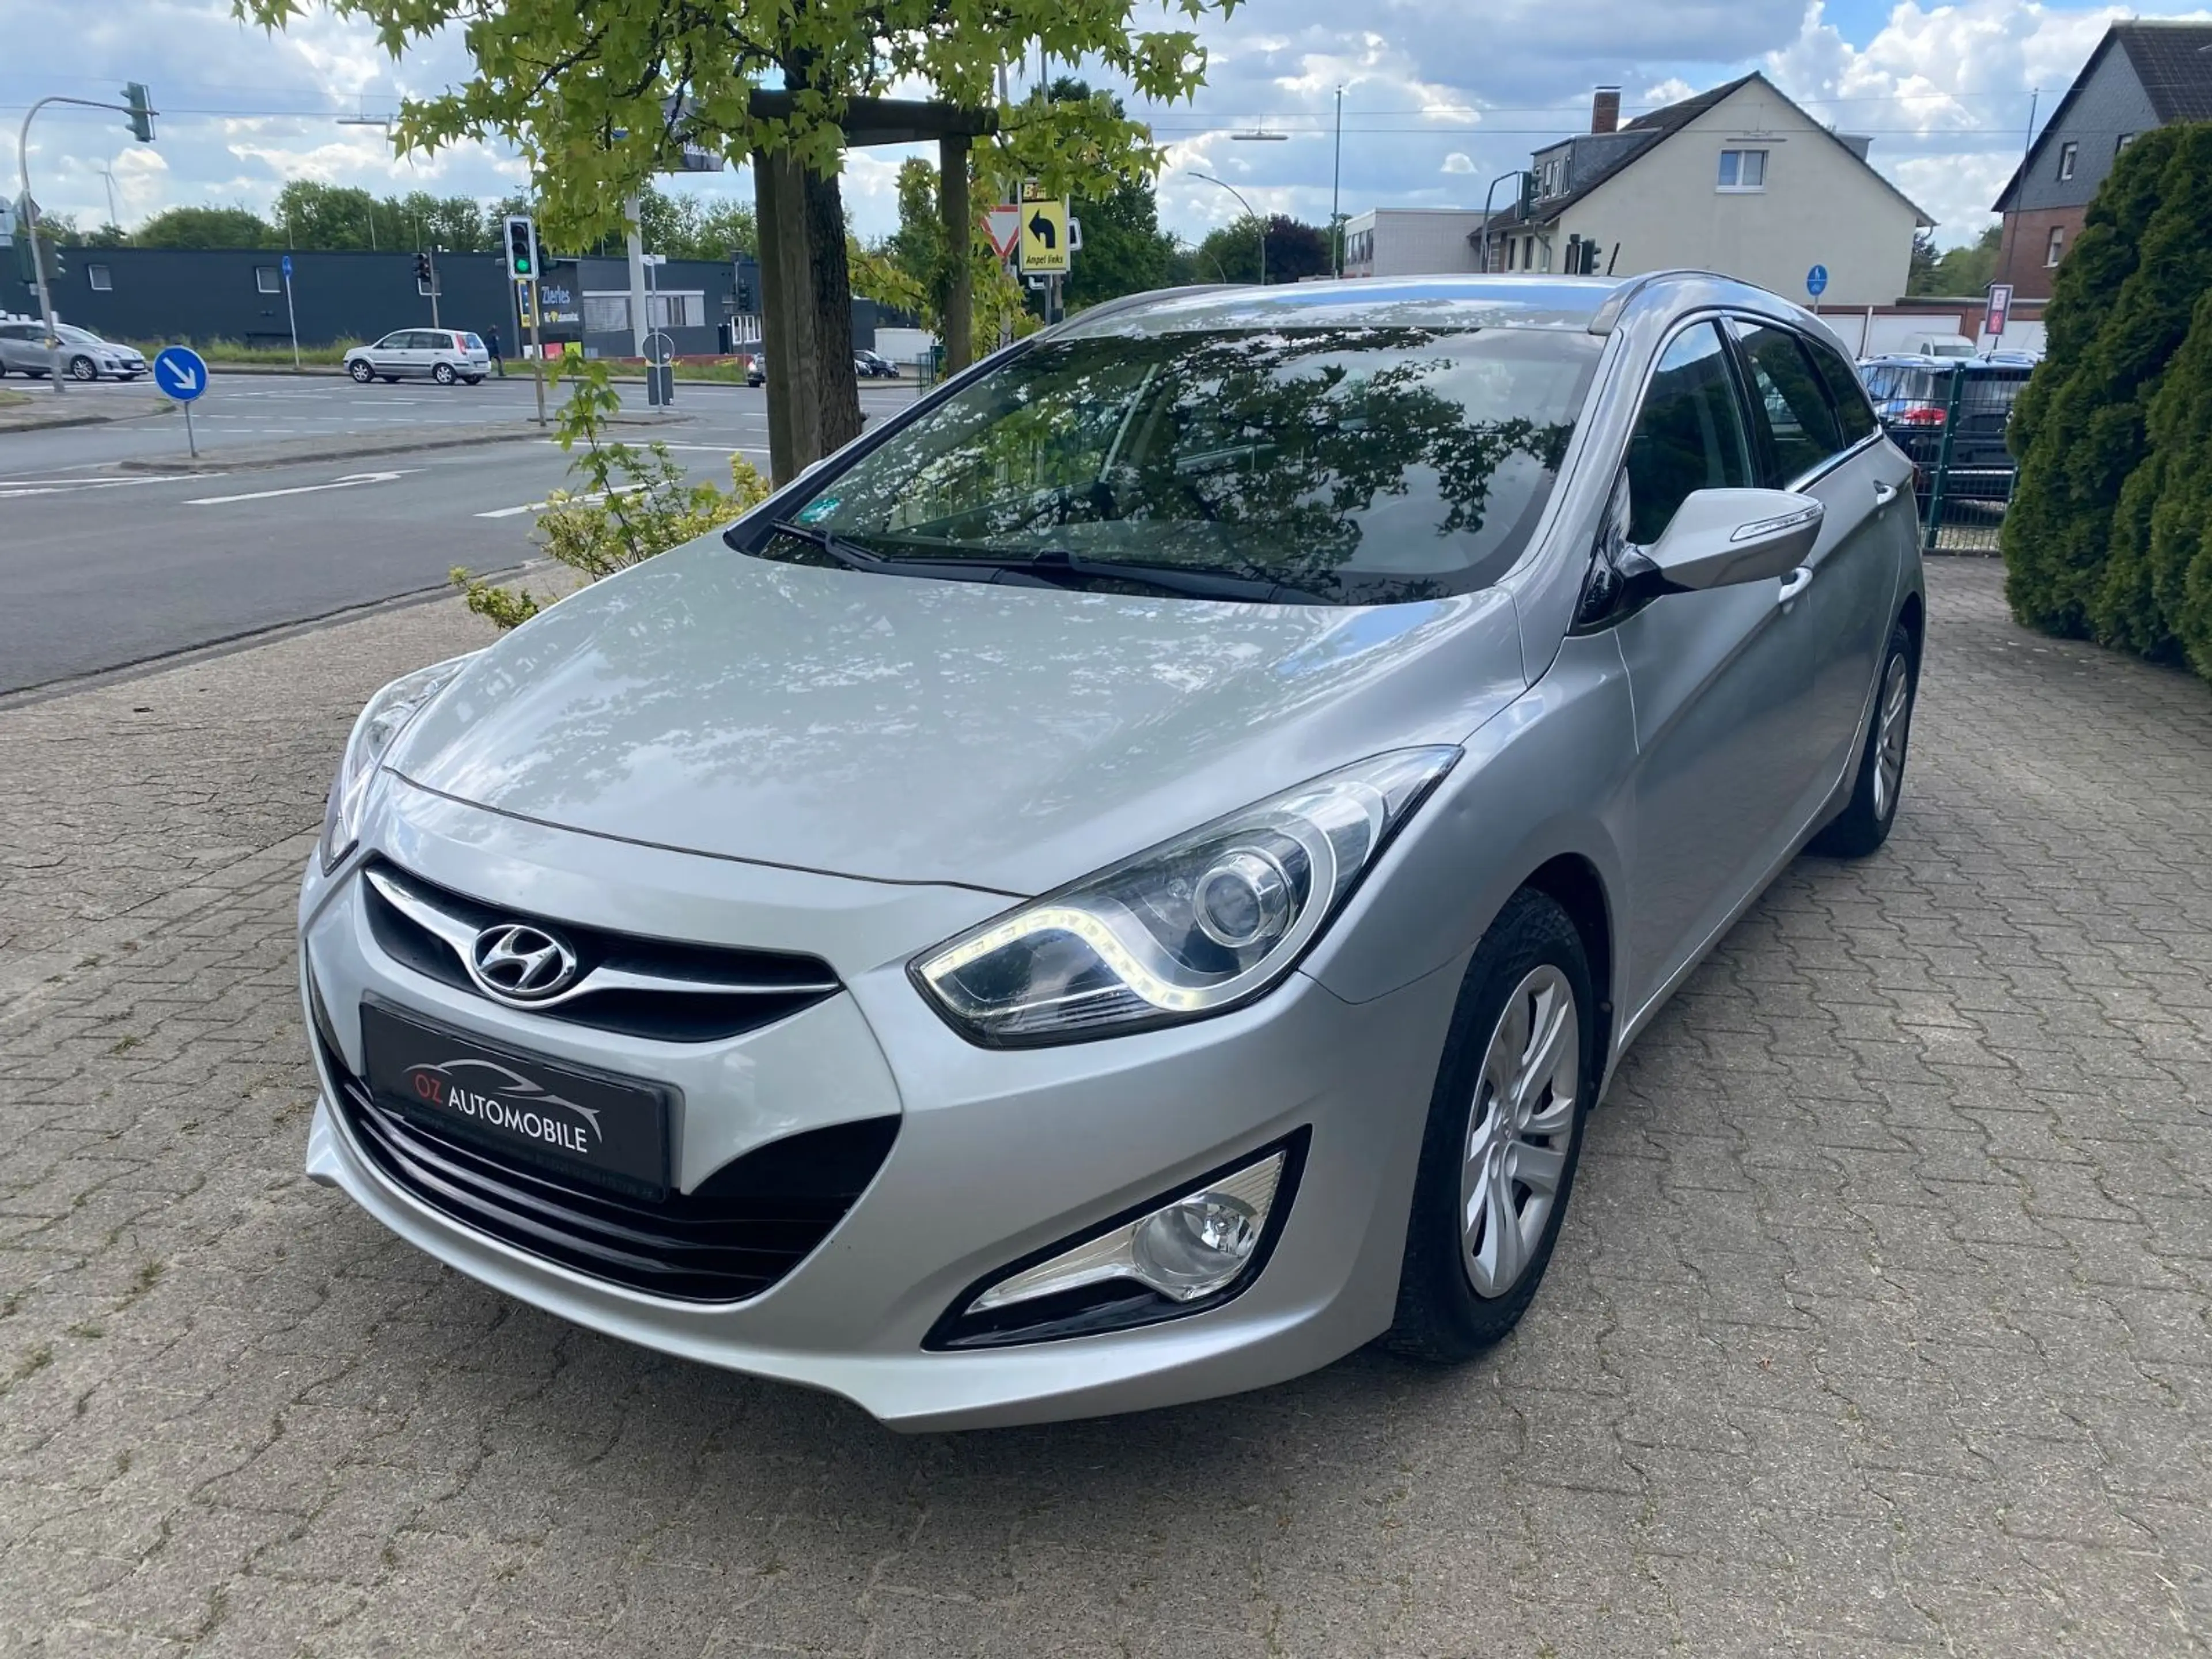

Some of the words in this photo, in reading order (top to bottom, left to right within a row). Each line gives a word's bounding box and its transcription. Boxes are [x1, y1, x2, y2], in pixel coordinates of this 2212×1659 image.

[1025, 254, 1046, 266] Ampel
[1048, 253, 1063, 264] links
[415, 1074, 443, 1104] OZ
[448, 1086, 588, 1153] AUTOMOBILE
